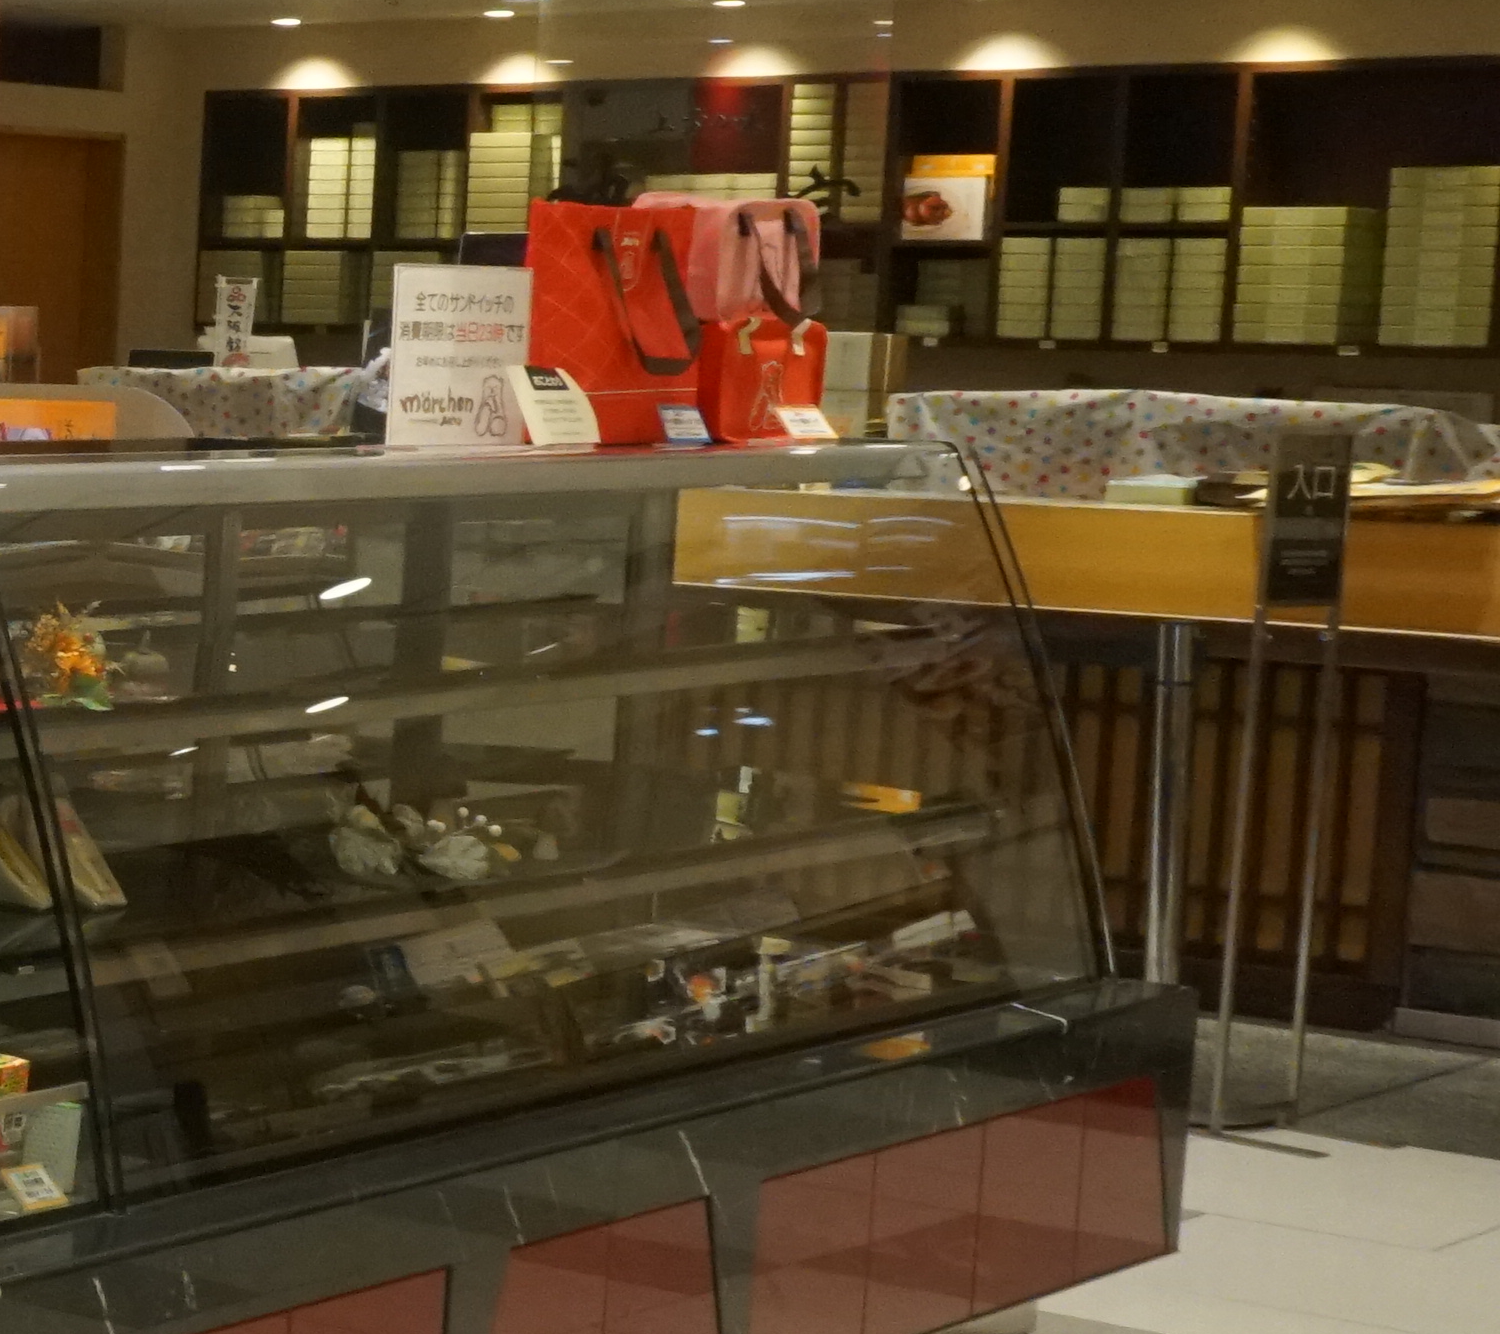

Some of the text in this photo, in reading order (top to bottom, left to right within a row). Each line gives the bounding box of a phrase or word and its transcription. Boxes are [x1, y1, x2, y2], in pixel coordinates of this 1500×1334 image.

[414, 291, 515, 314] 全てのサンドイッチの
[1286, 463, 1337, 500] 入口
